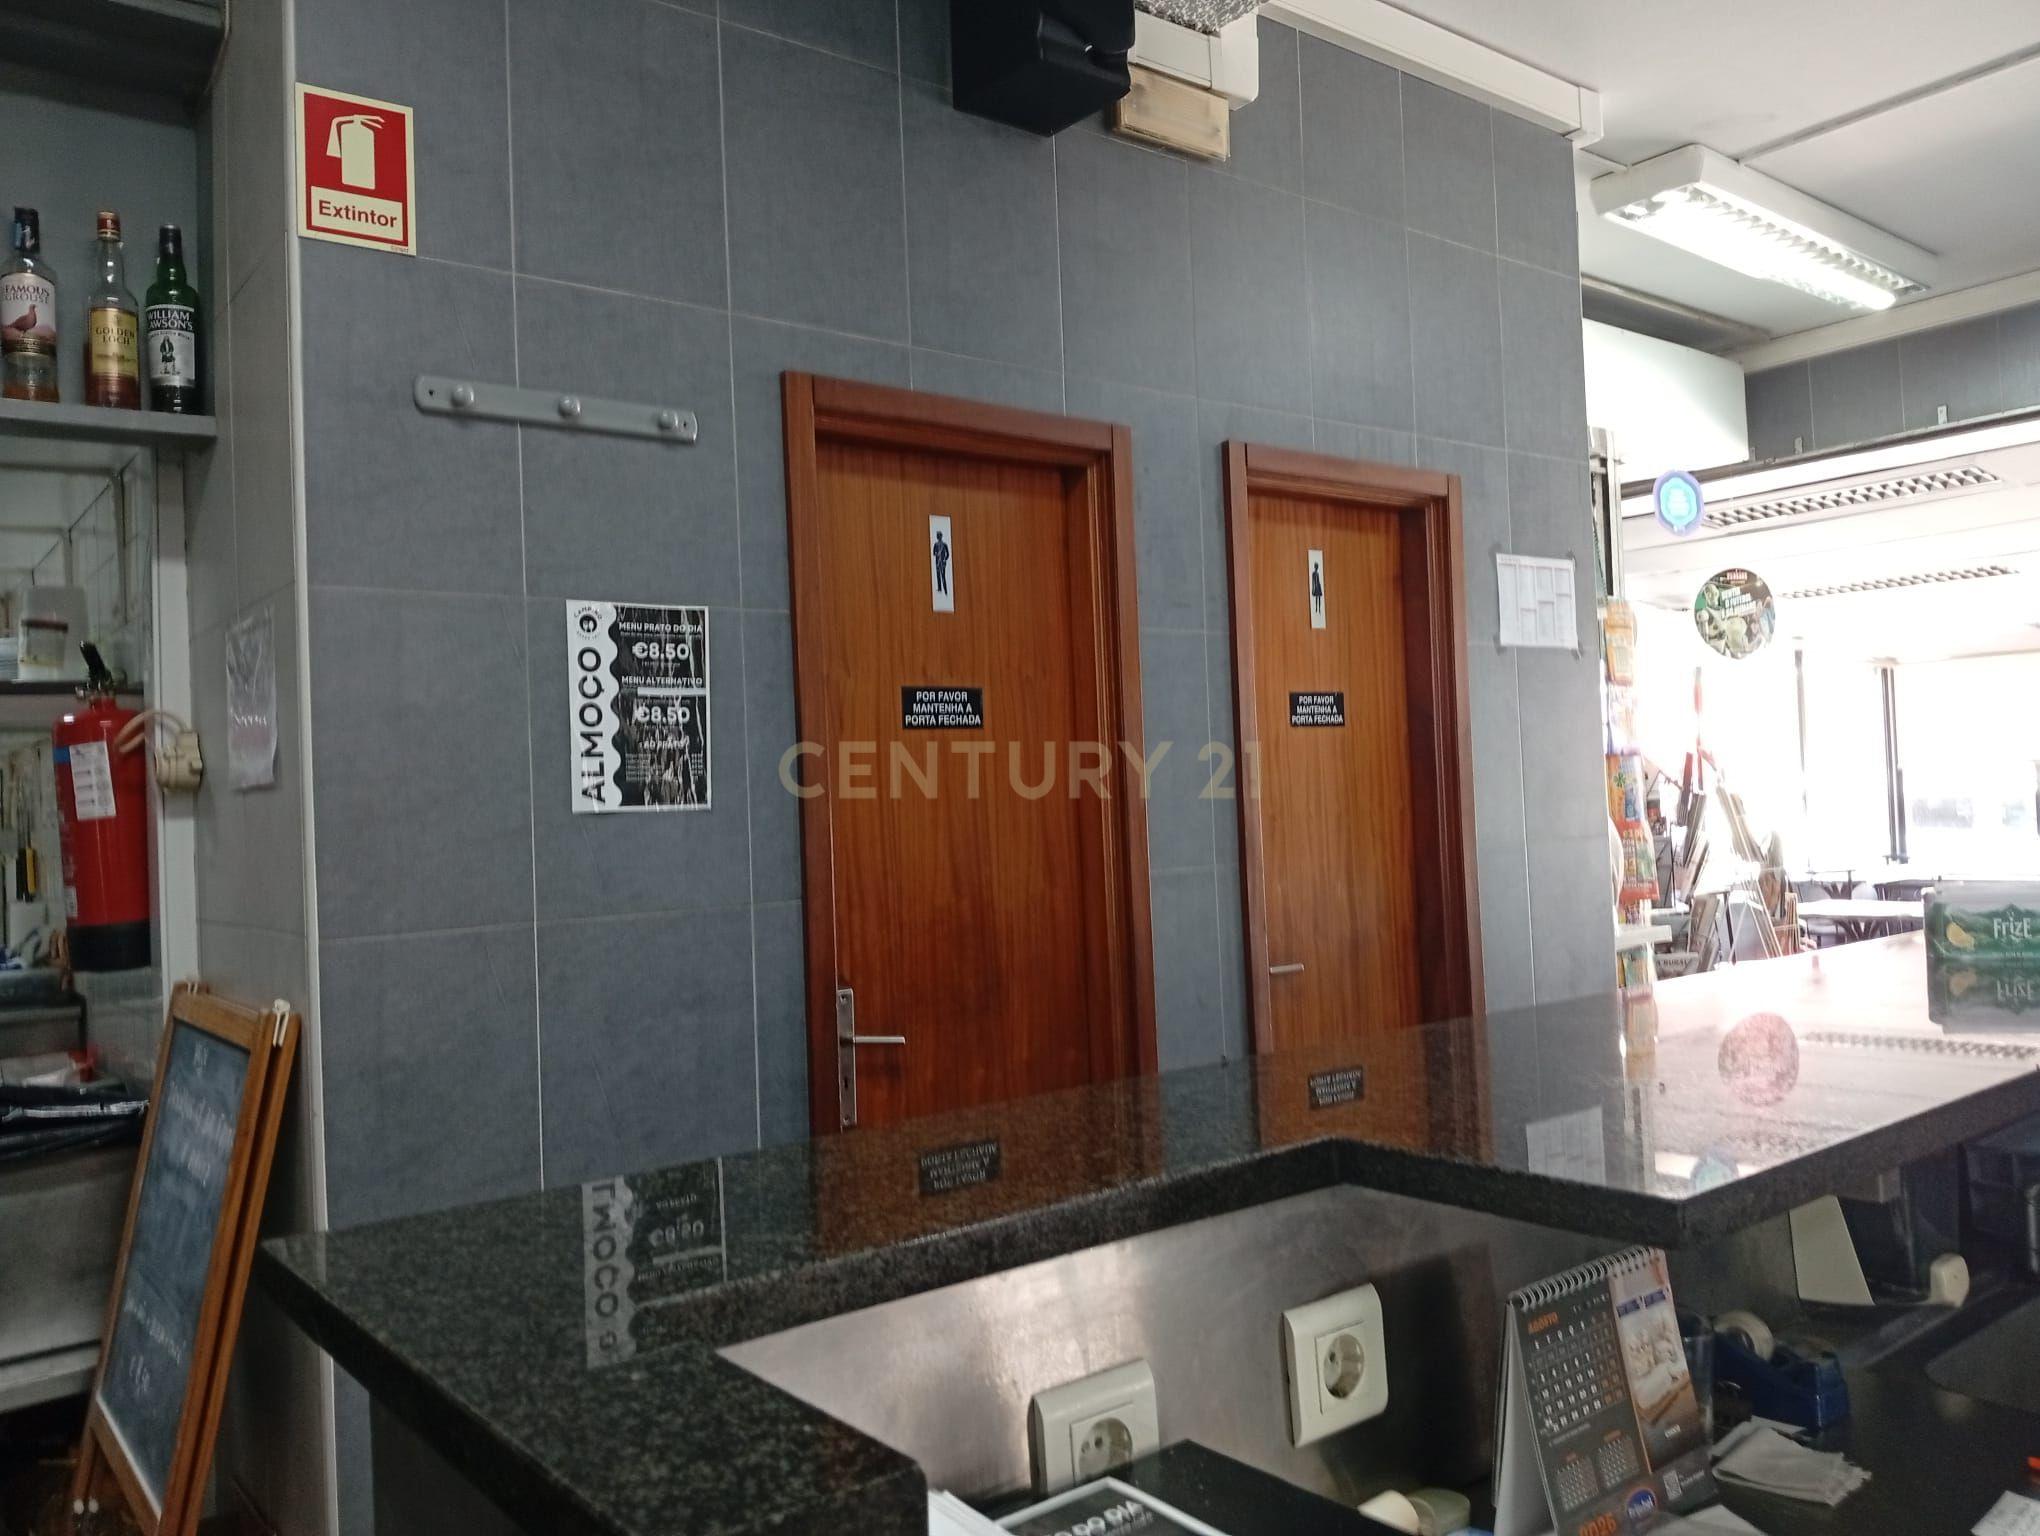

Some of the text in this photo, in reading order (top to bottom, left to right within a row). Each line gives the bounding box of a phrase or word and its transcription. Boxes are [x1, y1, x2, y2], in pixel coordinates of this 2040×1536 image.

[319, 199, 397, 228] Extintor
[5, 284, 50, 297] FAMOUS
[95, 326, 135, 338] GOLDEN
[102, 335, 130, 345] LOCH
[619, 622, 703, 634] MENU PRATO DO DIA
[632, 641, 690, 660] €8.50
[621, 676, 703, 687] MENU ALTERNATIVO
[916, 691, 968, 702] POR FAVOR
[1298, 695, 1334, 705] POR FAVOR
[912, 703, 973, 714] MANTENHA A
[1296, 705, 1338, 715] MANTENHA A
[577, 646, 606, 804] ALMOÇO
[905, 714, 981, 727] PORTA FECHADA
[1291, 714, 1344, 726] PORTA FECHADA
